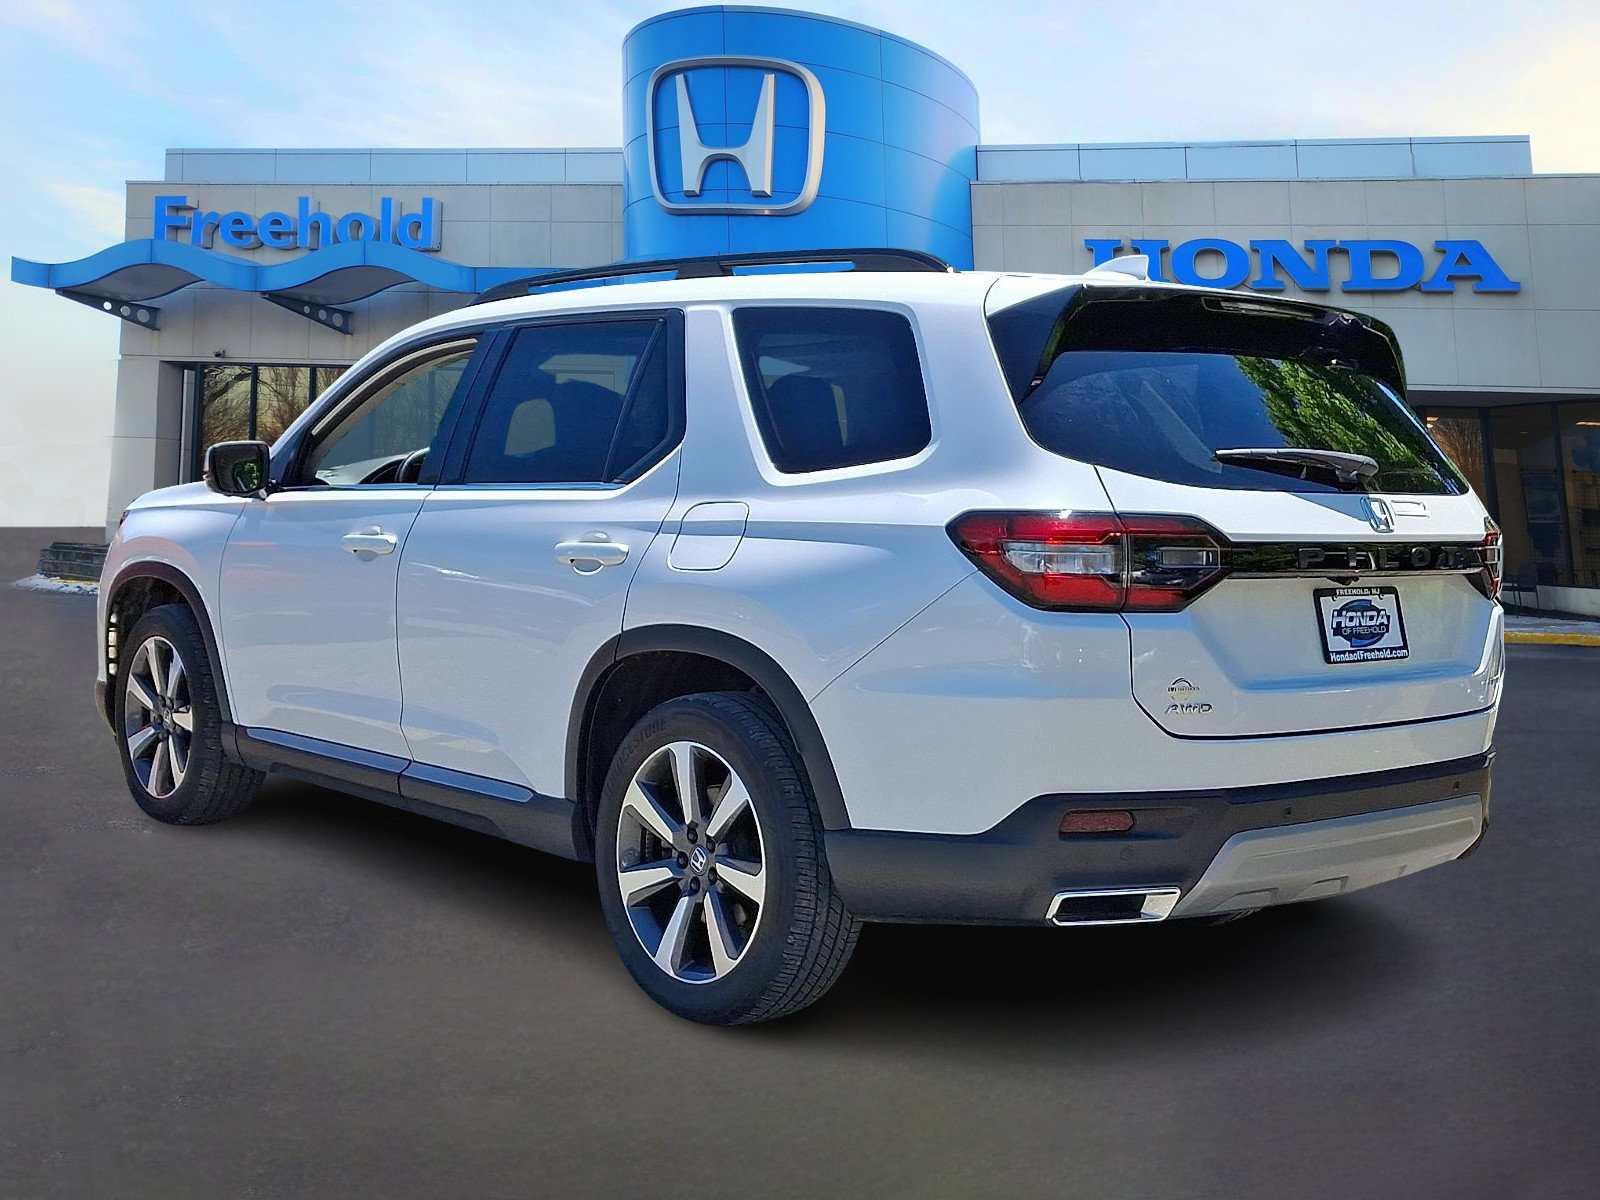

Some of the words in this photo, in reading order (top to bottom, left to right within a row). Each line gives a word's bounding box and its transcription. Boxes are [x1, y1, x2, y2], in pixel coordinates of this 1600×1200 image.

[153, 195, 438, 249] Freehold
[1084, 238, 1521, 293] HONDA
[1332, 610, 1388, 629] HONDA
[1341, 627, 1352, 636] OF
[1352, 625, 1387, 635] FREEHOLD
[1329, 648, 1408, 663] HondaofFreehold.com
[1165, 703, 1213, 714] AWD
